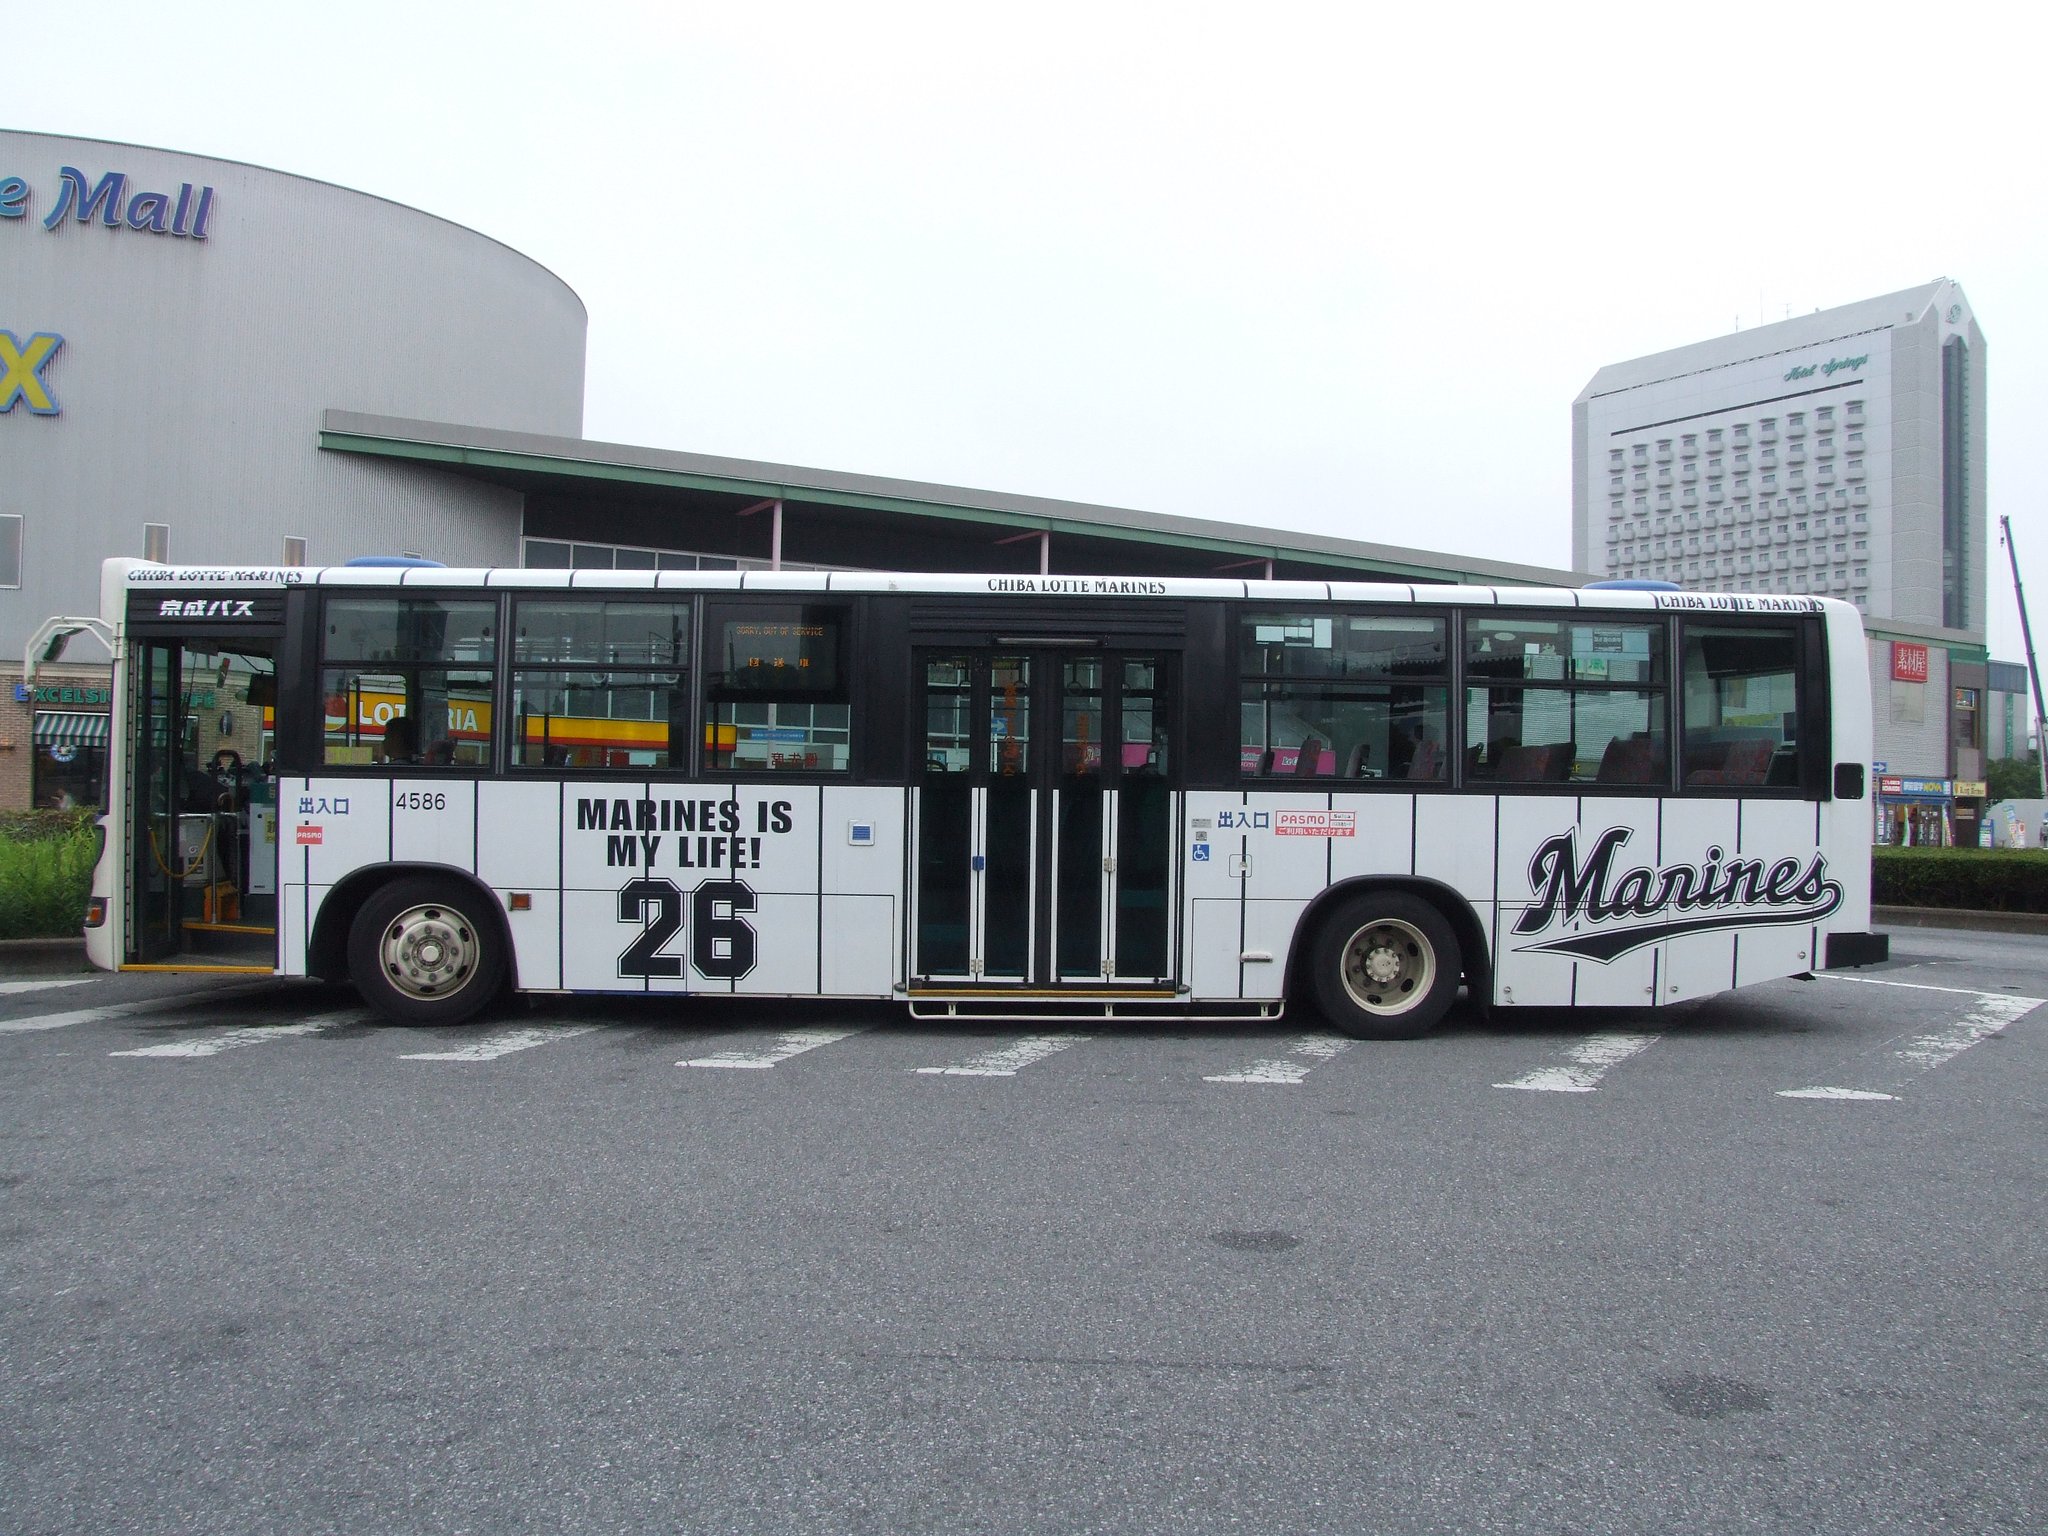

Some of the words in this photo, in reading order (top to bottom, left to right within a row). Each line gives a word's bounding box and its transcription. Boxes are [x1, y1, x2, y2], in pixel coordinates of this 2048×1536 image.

[43, 165, 214, 238] Mall
[1784, 364, 1817, 382] Hotel
[127, 569, 175, 581] CHIBA
[179, 570, 230, 581] LOTTE
[231, 571, 304, 583] MARINES
[987, 578, 1036, 592] CHIBA
[1041, 579, 1090, 593] LOTTE
[1094, 580, 1166, 595] MARINES
[160, 600, 255, 617] 京成バス
[1660, 595, 1706, 609] CHIBA
[1709, 597, 1755, 610] LOTTE
[1759, 598, 1825, 612] MARINES
[1897, 647, 1926, 673] 素材屋
[298, 797, 350, 815] 出入口
[395, 792, 446, 811] 4586
[577, 798, 740, 833] MARINES
[757, 801, 793, 833] IS
[1218, 811, 1270, 829] 出入口
[1281, 814, 1325, 825] PASMO
[1278, 827, 1353, 836] ご利用いただけます
[607, 835, 661, 867] MY
[679, 836, 761, 869] LIFE!
[1510, 826, 1844, 940] Marines
[616, 876, 758, 981] 26
